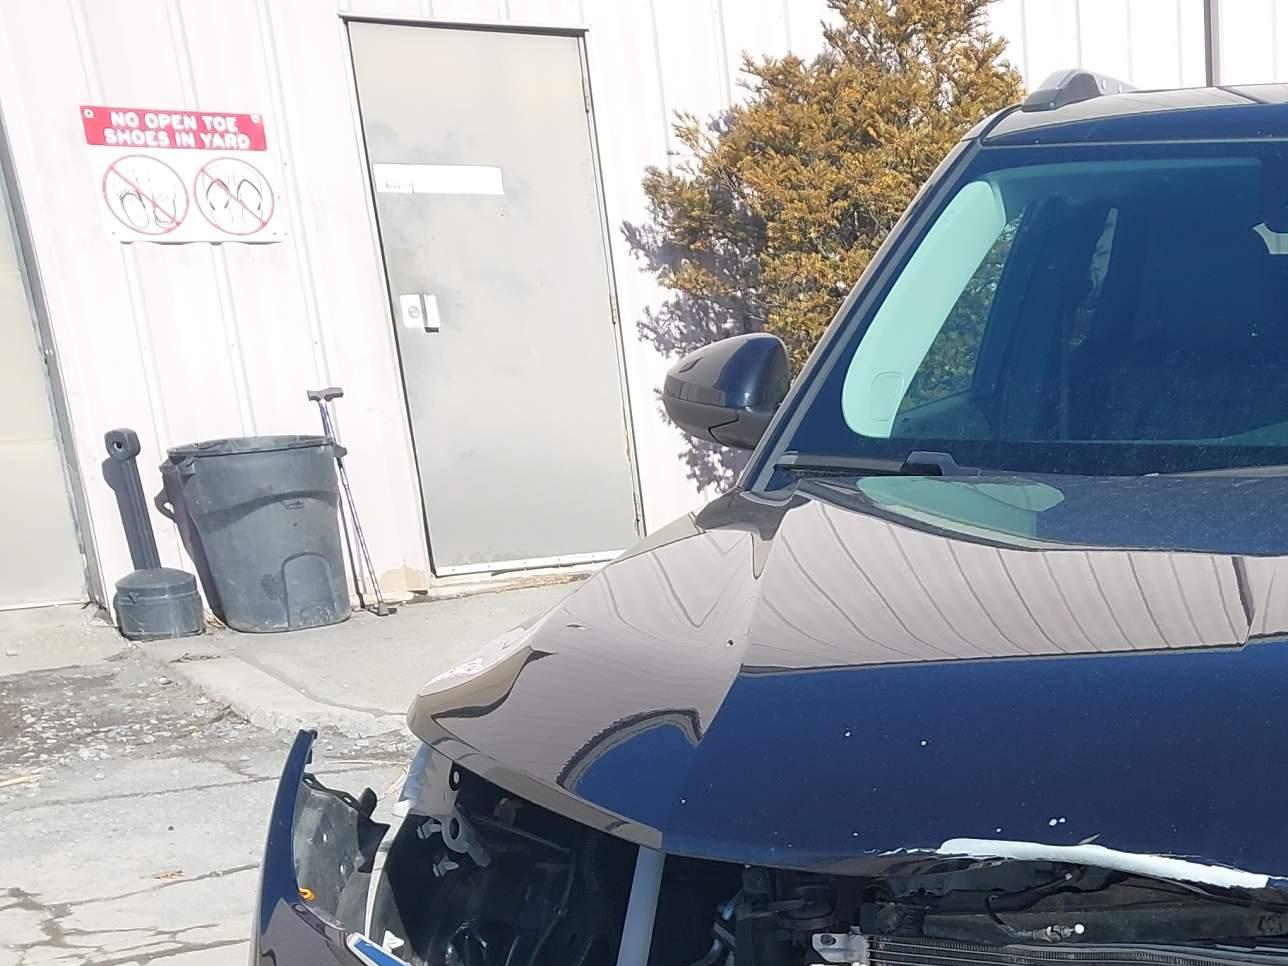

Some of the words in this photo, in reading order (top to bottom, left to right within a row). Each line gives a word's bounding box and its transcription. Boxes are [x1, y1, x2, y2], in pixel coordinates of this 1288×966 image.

[110, 111, 140, 128] NO
[144, 113, 197, 130] OPEN
[202, 115, 238, 132] TOE
[103, 128, 169, 147] SHOES
[174, 132, 196, 148] IN
[200, 132, 250, 149] YARD
